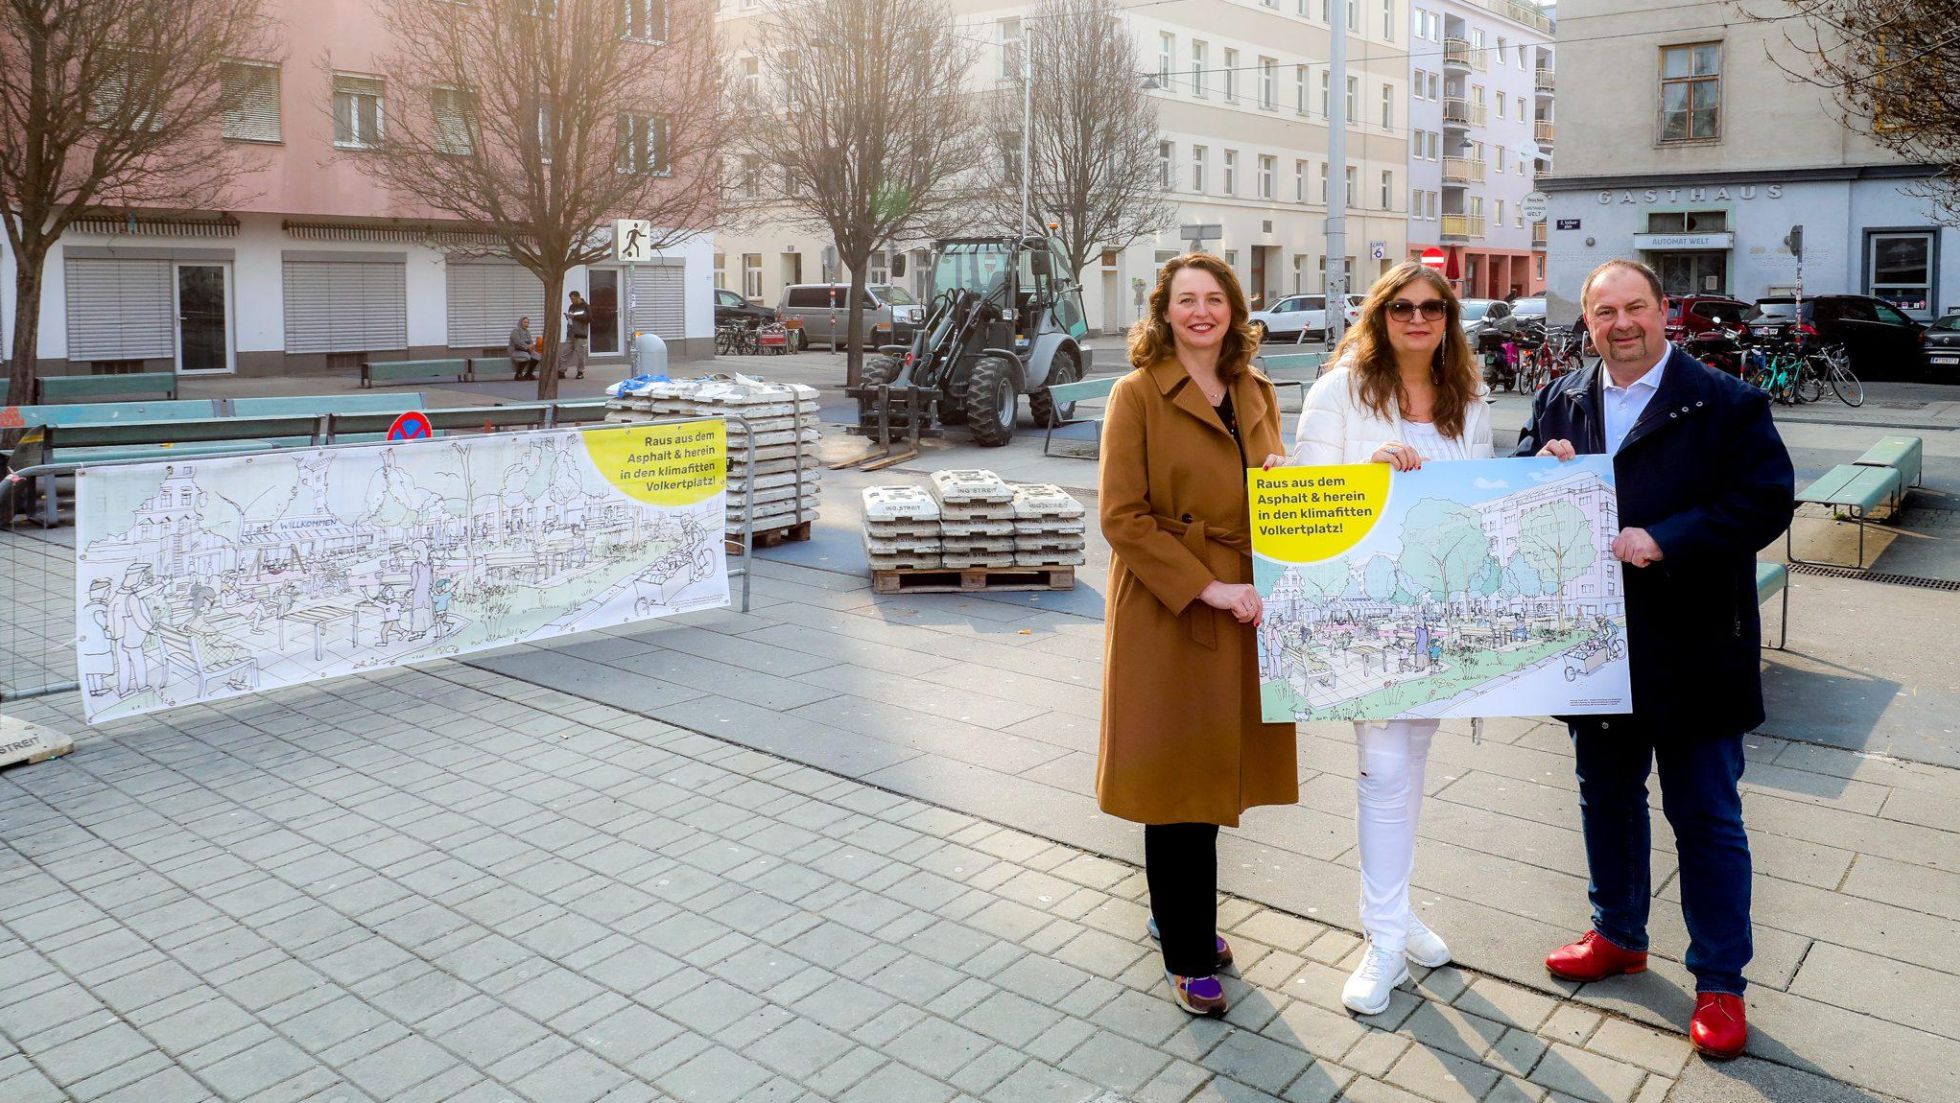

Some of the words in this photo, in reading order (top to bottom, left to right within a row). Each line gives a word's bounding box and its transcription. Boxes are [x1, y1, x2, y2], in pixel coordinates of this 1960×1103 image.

[1597, 184, 1784, 205] GASTHAUS
[1652, 237, 1687, 246] AUTOMAT
[1689, 237, 1710, 245] WELT
[644, 436, 673, 447] Raus
[674, 434, 694, 444] aus
[695, 431, 715, 441] dem
[627, 450, 672, 464] Asphalt
[674, 449, 682, 459] &
[684, 445, 715, 458] herein
[620, 469, 631, 480] in
[633, 468, 656, 479] den
[658, 462, 715, 476] klimafitten
[646, 476, 716, 491] Volkertplatz!
[1256, 478, 1289, 489] Raus
[1291, 478, 1315, 488] aus
[1317, 476, 1345, 487] dem
[1257, 492, 1308, 506] Asphalt
[1311, 492, 1320, 503] &
[1323, 490, 1365, 502] herein
[1258, 509, 1270, 520] in
[1273, 509, 1298, 520] den
[1300, 505, 1373, 519] klimafitten
[280, 519, 336, 530] WILLKOMMEN
[1259, 522, 1343, 536] Volkertplatz!
[0, 736, 40, 754] STREIT
